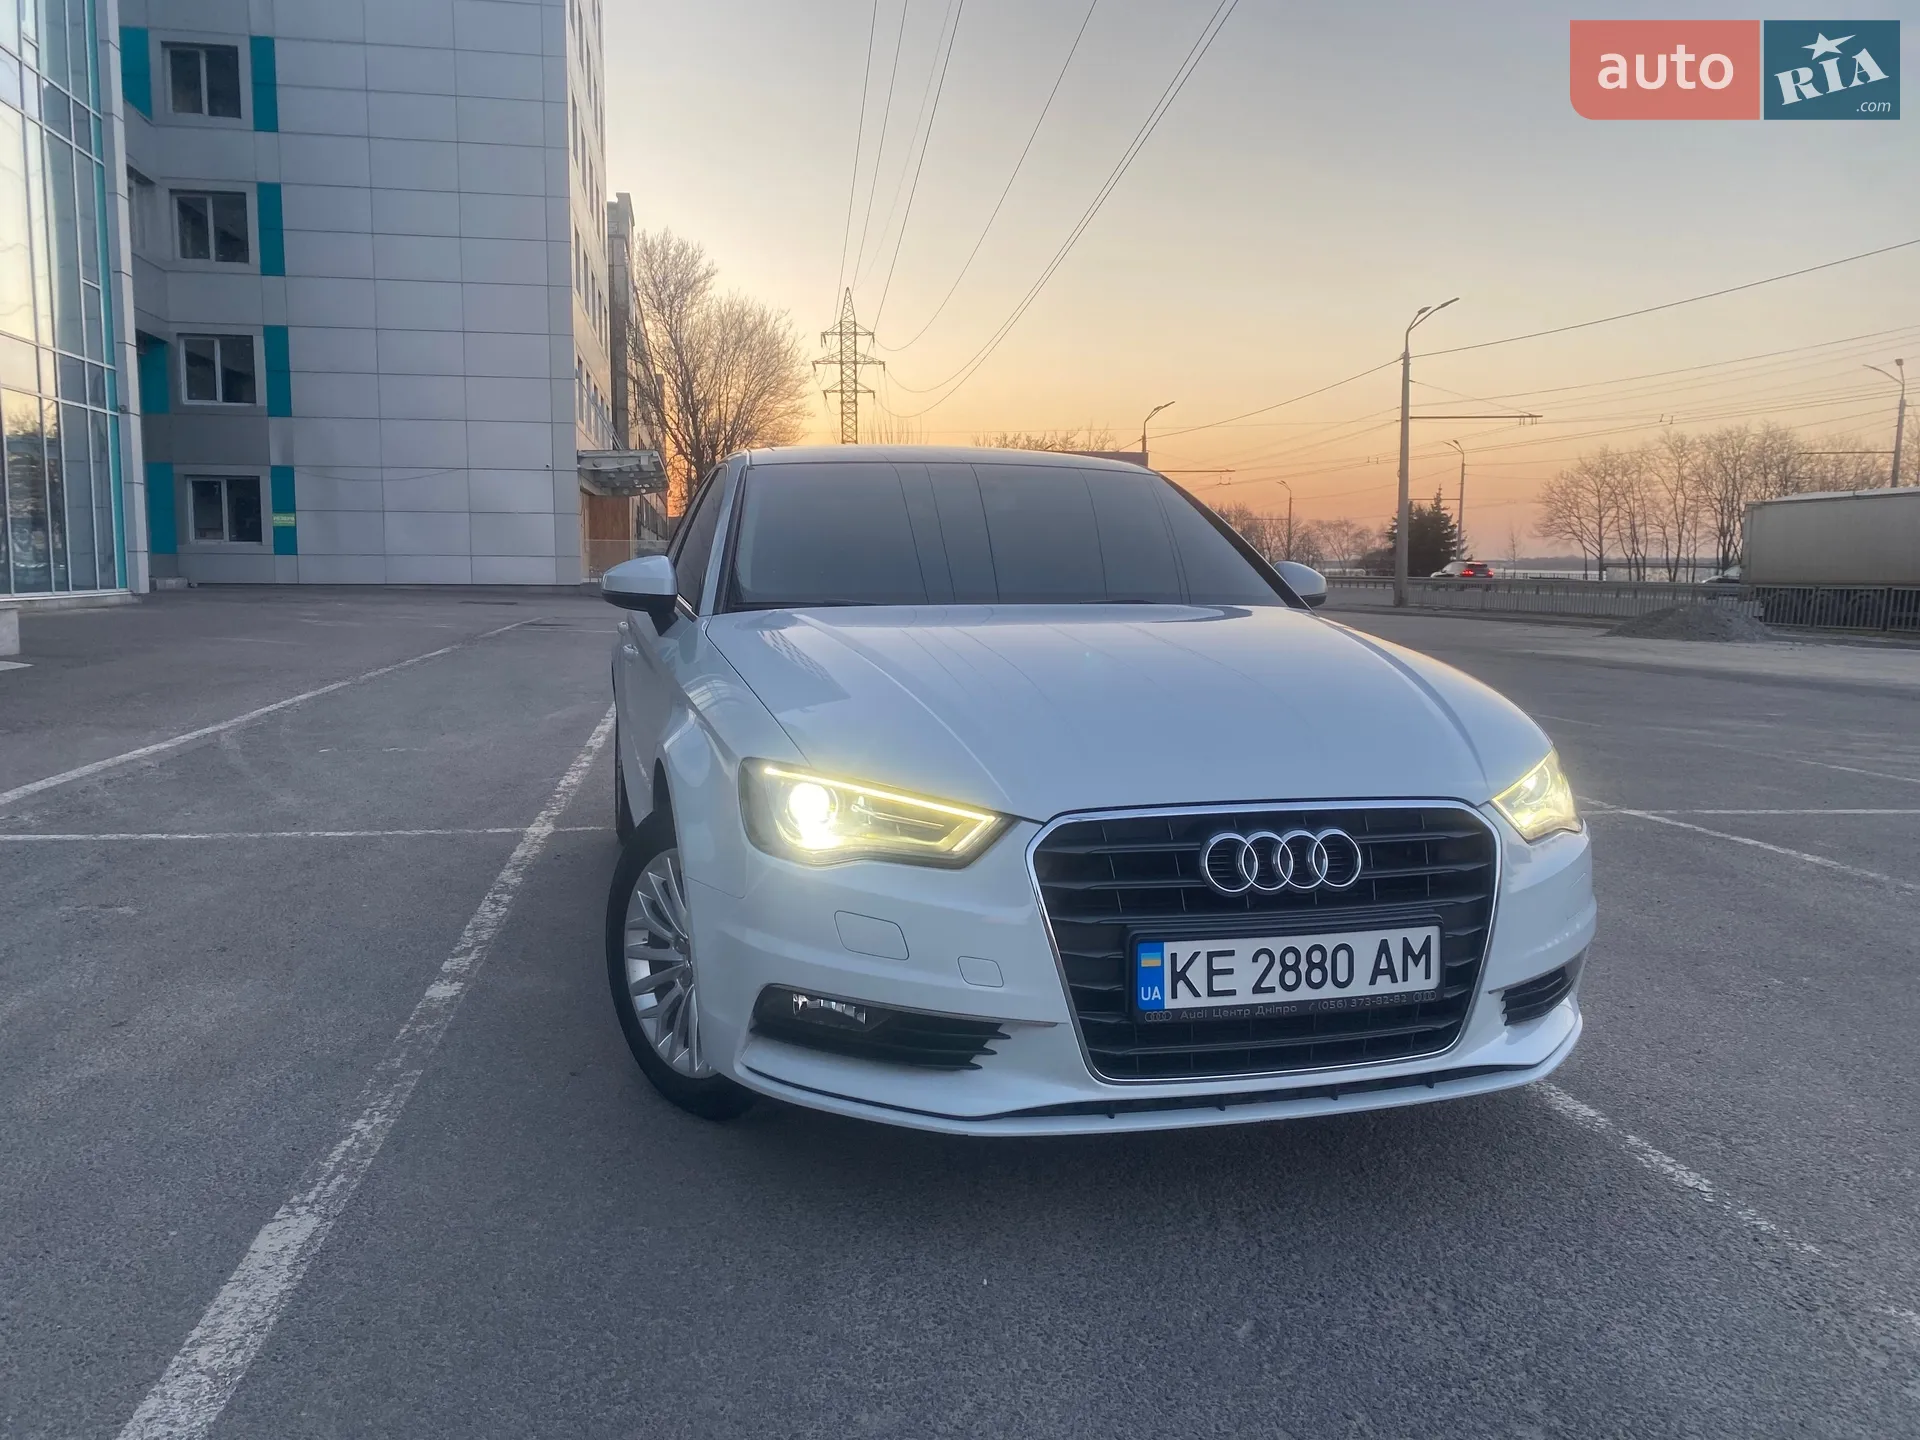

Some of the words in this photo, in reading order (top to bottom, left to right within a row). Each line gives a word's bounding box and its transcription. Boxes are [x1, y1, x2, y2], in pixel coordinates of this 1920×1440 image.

[1170, 950, 1237, 1000] KE
[1251, 943, 1355, 994] 2880
[1369, 934, 1432, 986] AM
[1141, 986, 1161, 1001] UA
[1180, 1010, 1208, 1020] Audi
[1212, 1008, 1250, 1018] Центр
[1255, 1005, 1298, 1016] Дніпро
[1317, 1000, 1348, 1011] (056)
